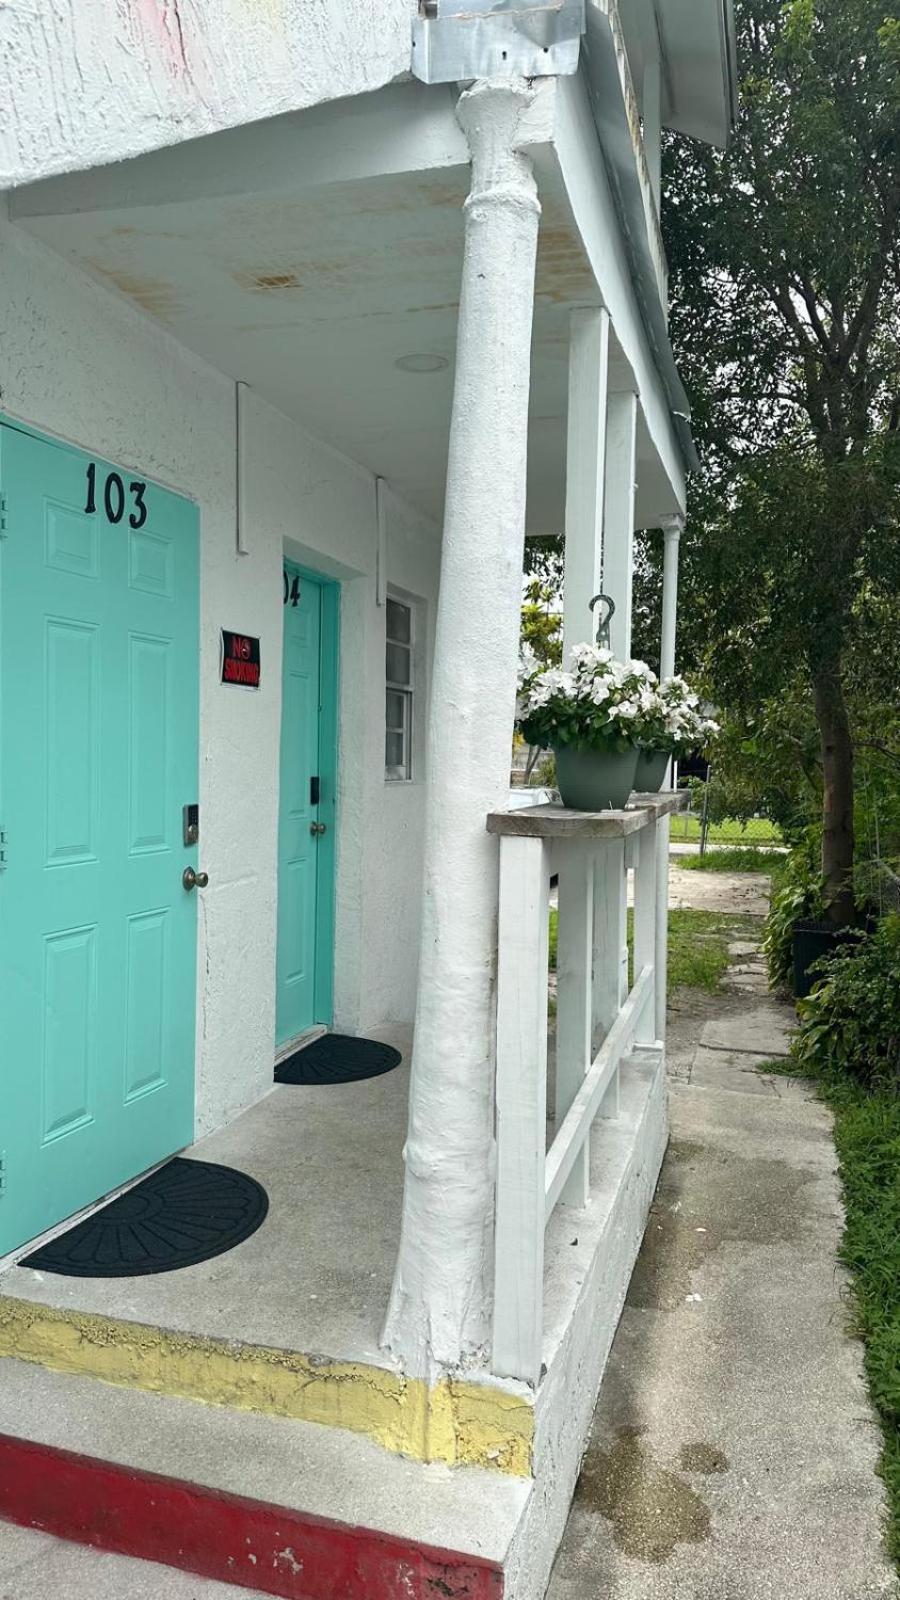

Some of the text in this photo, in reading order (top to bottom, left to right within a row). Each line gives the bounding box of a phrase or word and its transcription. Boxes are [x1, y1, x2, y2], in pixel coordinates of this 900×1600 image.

[85, 463, 147, 529] 103
[232, 635, 251, 660] NO
[224, 657, 259, 684] SMOKING
